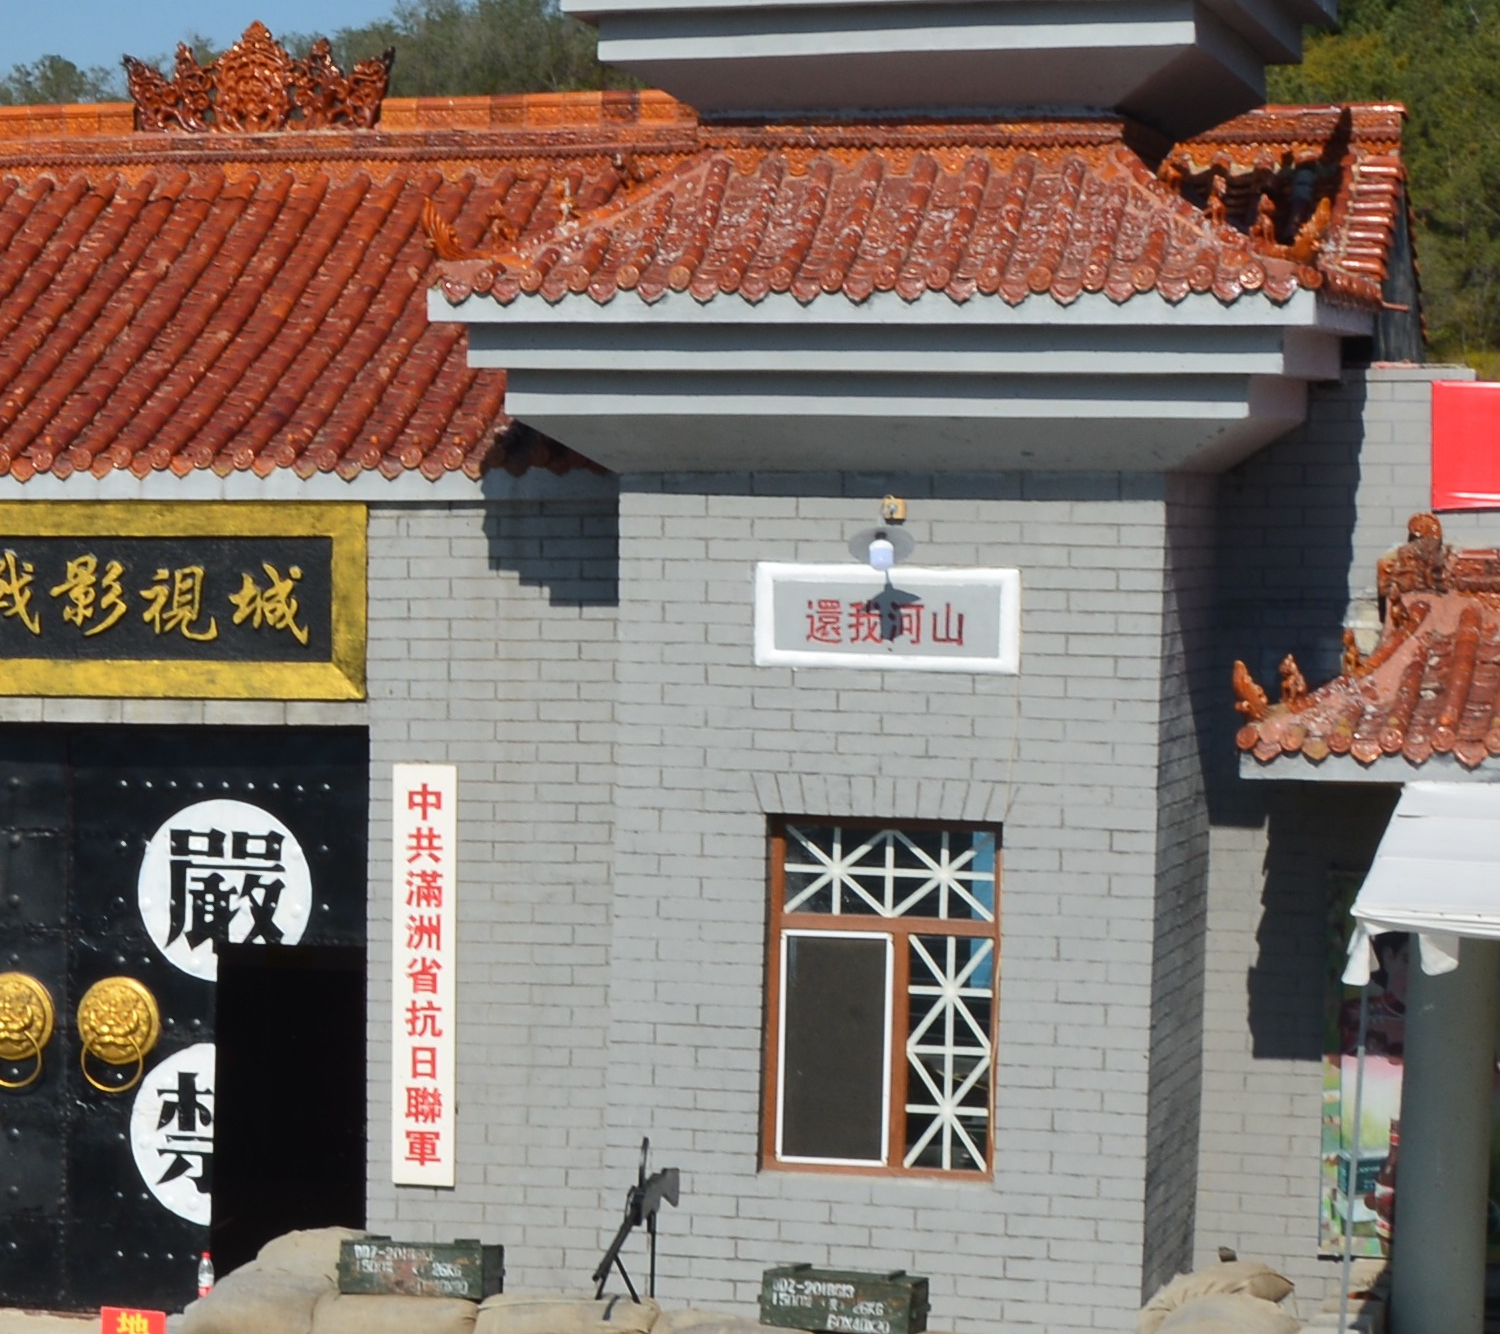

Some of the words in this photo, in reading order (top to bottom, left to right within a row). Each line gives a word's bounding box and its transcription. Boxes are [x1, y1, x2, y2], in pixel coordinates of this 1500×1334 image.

[805, 598, 965, 647] 還我河山
[404, 783, 443, 1166] 中共滿洲省抗日聯軍
